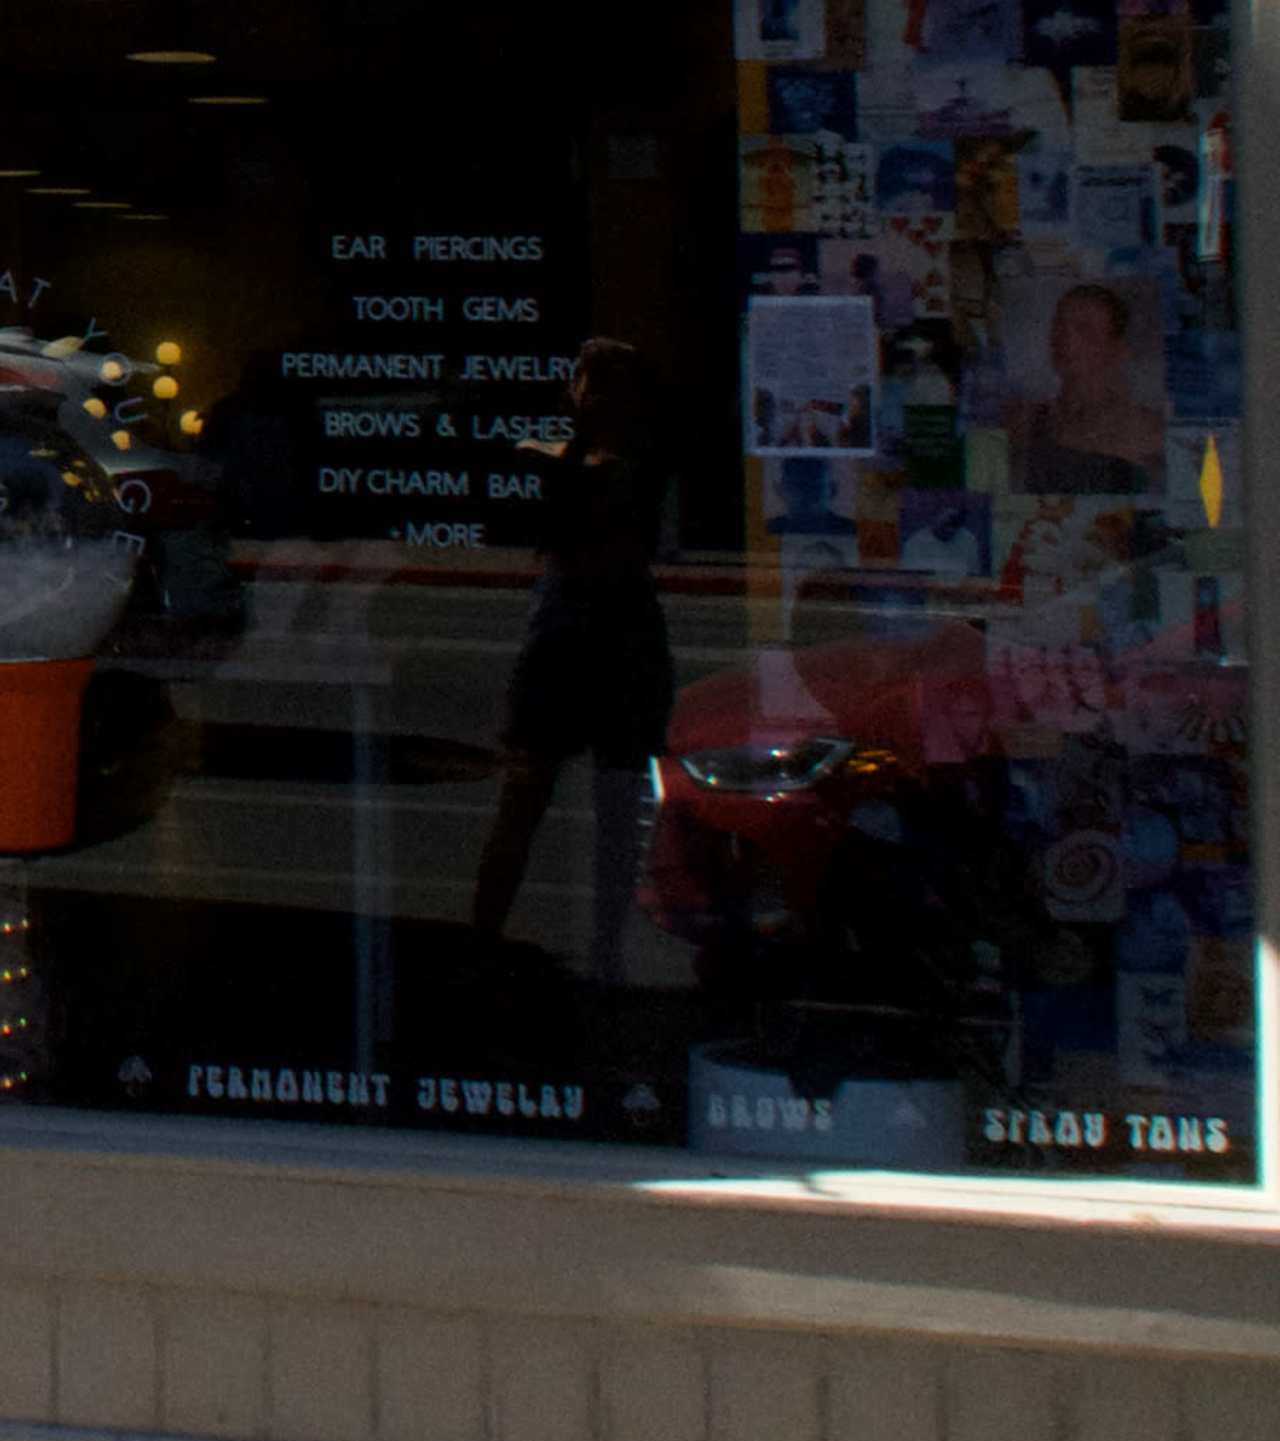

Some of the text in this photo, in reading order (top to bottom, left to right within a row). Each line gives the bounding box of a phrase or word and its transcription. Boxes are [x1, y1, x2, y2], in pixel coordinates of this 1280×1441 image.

[330, 234, 545, 262] EAR PIERCINGS
[351, 295, 540, 323] TOOTH GEMS
[280, 353, 580, 382] PERMANENT JEWELRY
[322, 411, 576, 441] BROWS & LASHES
[317, 467, 544, 500] DIY CHARM BAR
[185, 1062, 586, 1121] PERMANENT JEWELRY
[706, 1092, 835, 1132] BROWS
[981, 1105, 1230, 1153] SPRAY TANS
